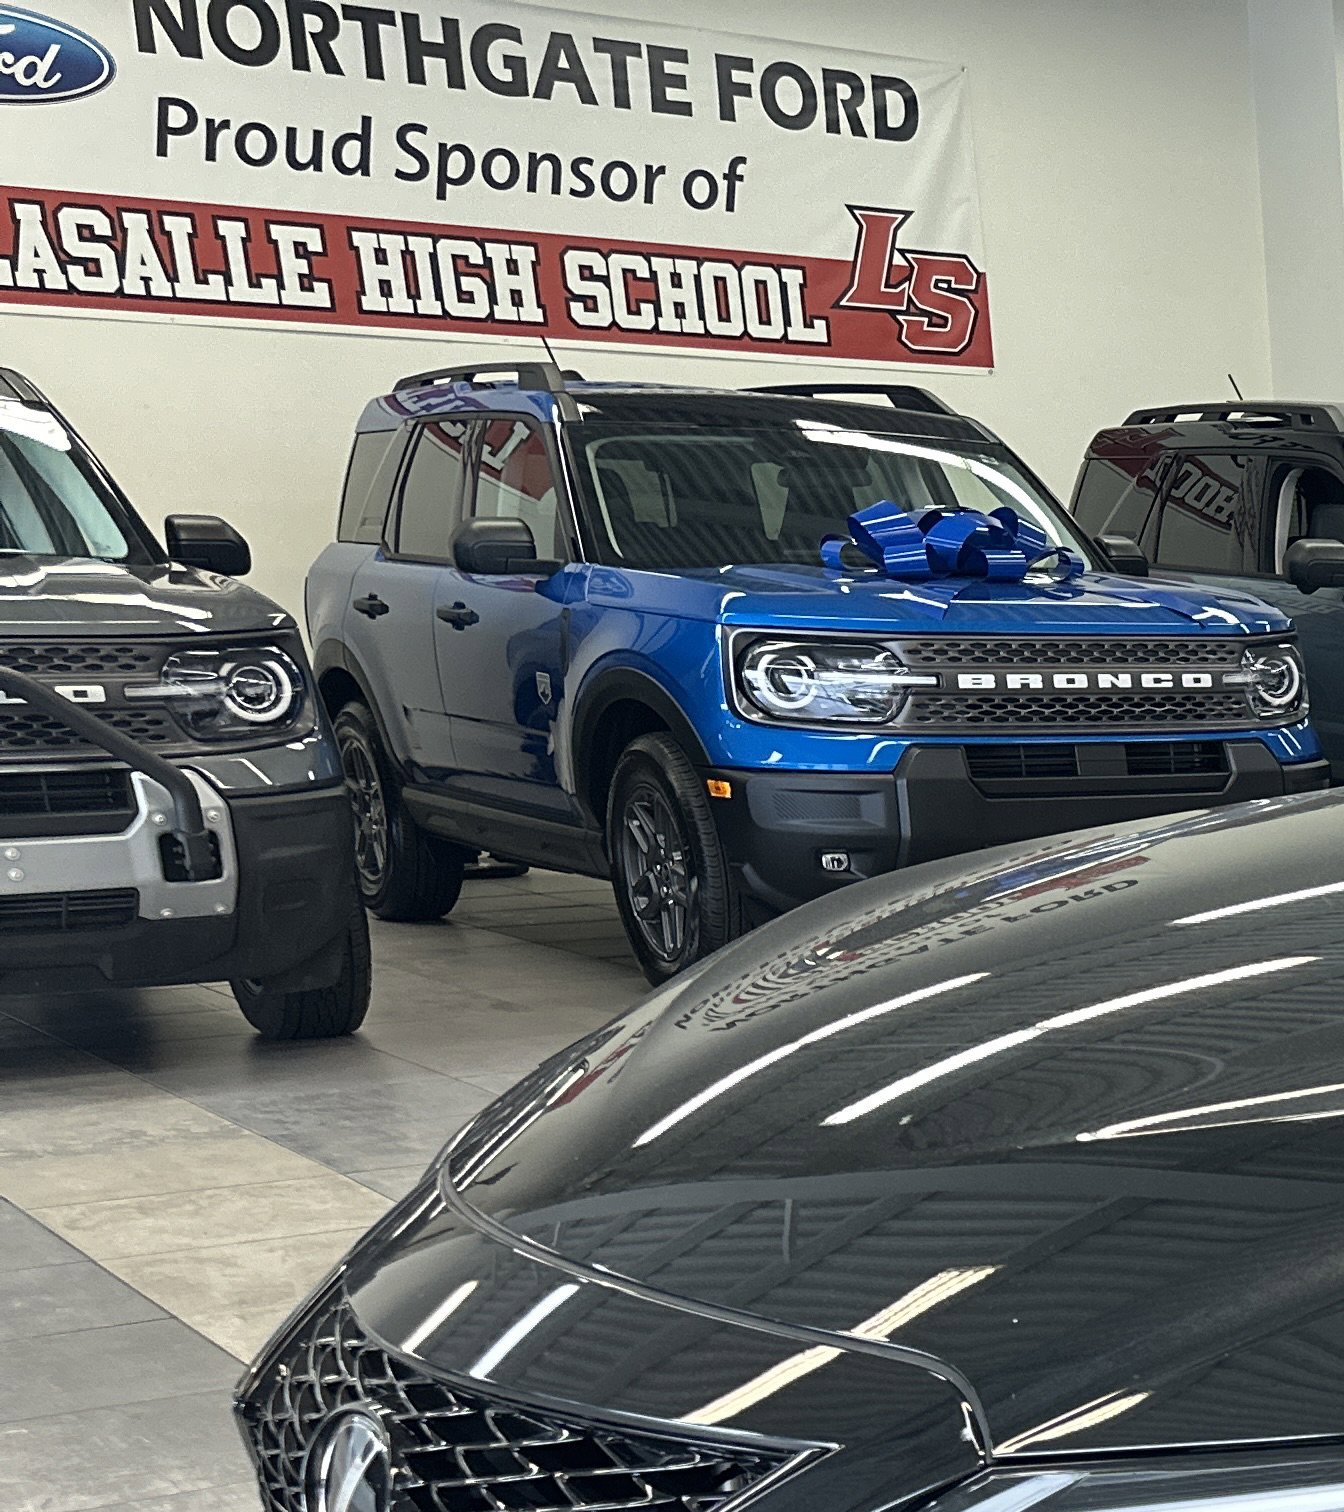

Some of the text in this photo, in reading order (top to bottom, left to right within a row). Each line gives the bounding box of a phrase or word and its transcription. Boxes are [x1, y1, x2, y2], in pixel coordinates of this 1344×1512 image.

[132, 0, 919, 142] NORTHGATE FORD
[156, 96, 748, 213] Proud Sponsor of
[0, 200, 829, 344] ASALLE HIGH SCHOOL
[831, 204, 979, 356] LS
[957, 673, 1213, 689] BRONCO
